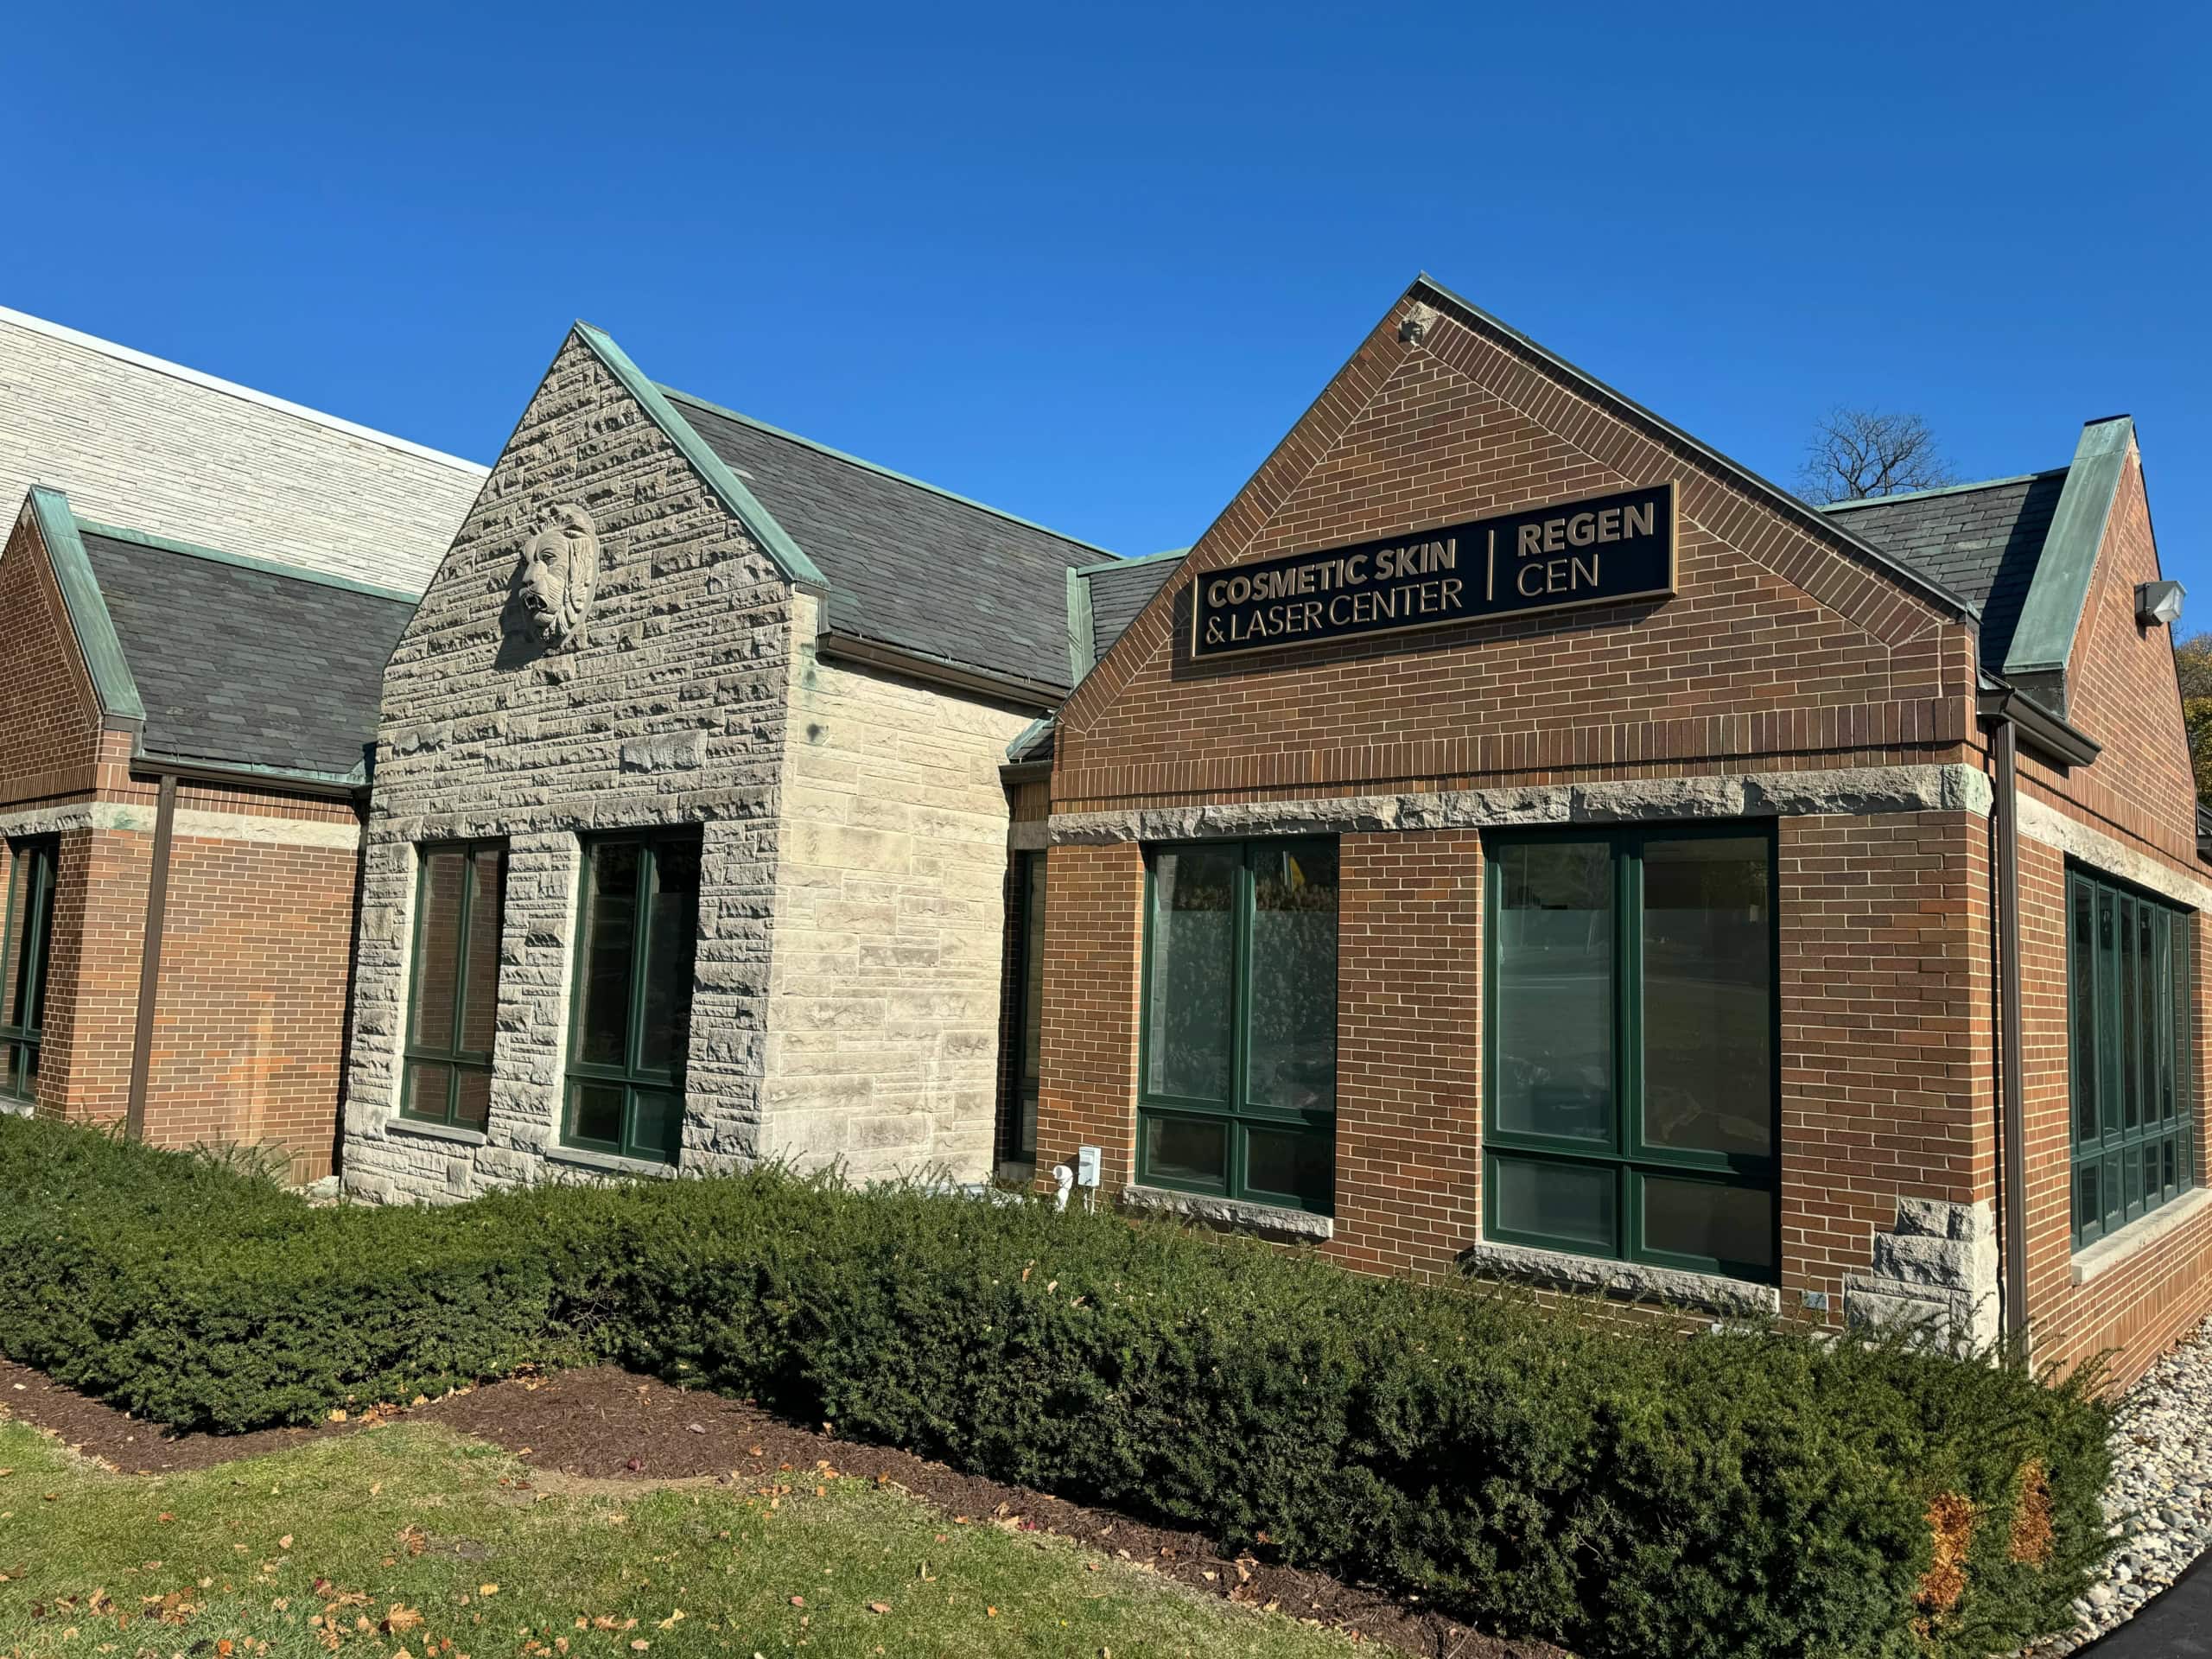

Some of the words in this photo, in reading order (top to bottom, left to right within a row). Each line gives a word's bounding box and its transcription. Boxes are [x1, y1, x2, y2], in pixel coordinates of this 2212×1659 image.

[1517, 502, 1654, 557] REGEN
[1207, 554, 1369, 608] COSMETIC
[1374, 538, 1457, 581] SKIN
[1516, 553, 1599, 597] CEN
[1205, 615, 1226, 645] &
[1230, 601, 1323, 642] LASER
[1328, 578, 1464, 626] CENTER
